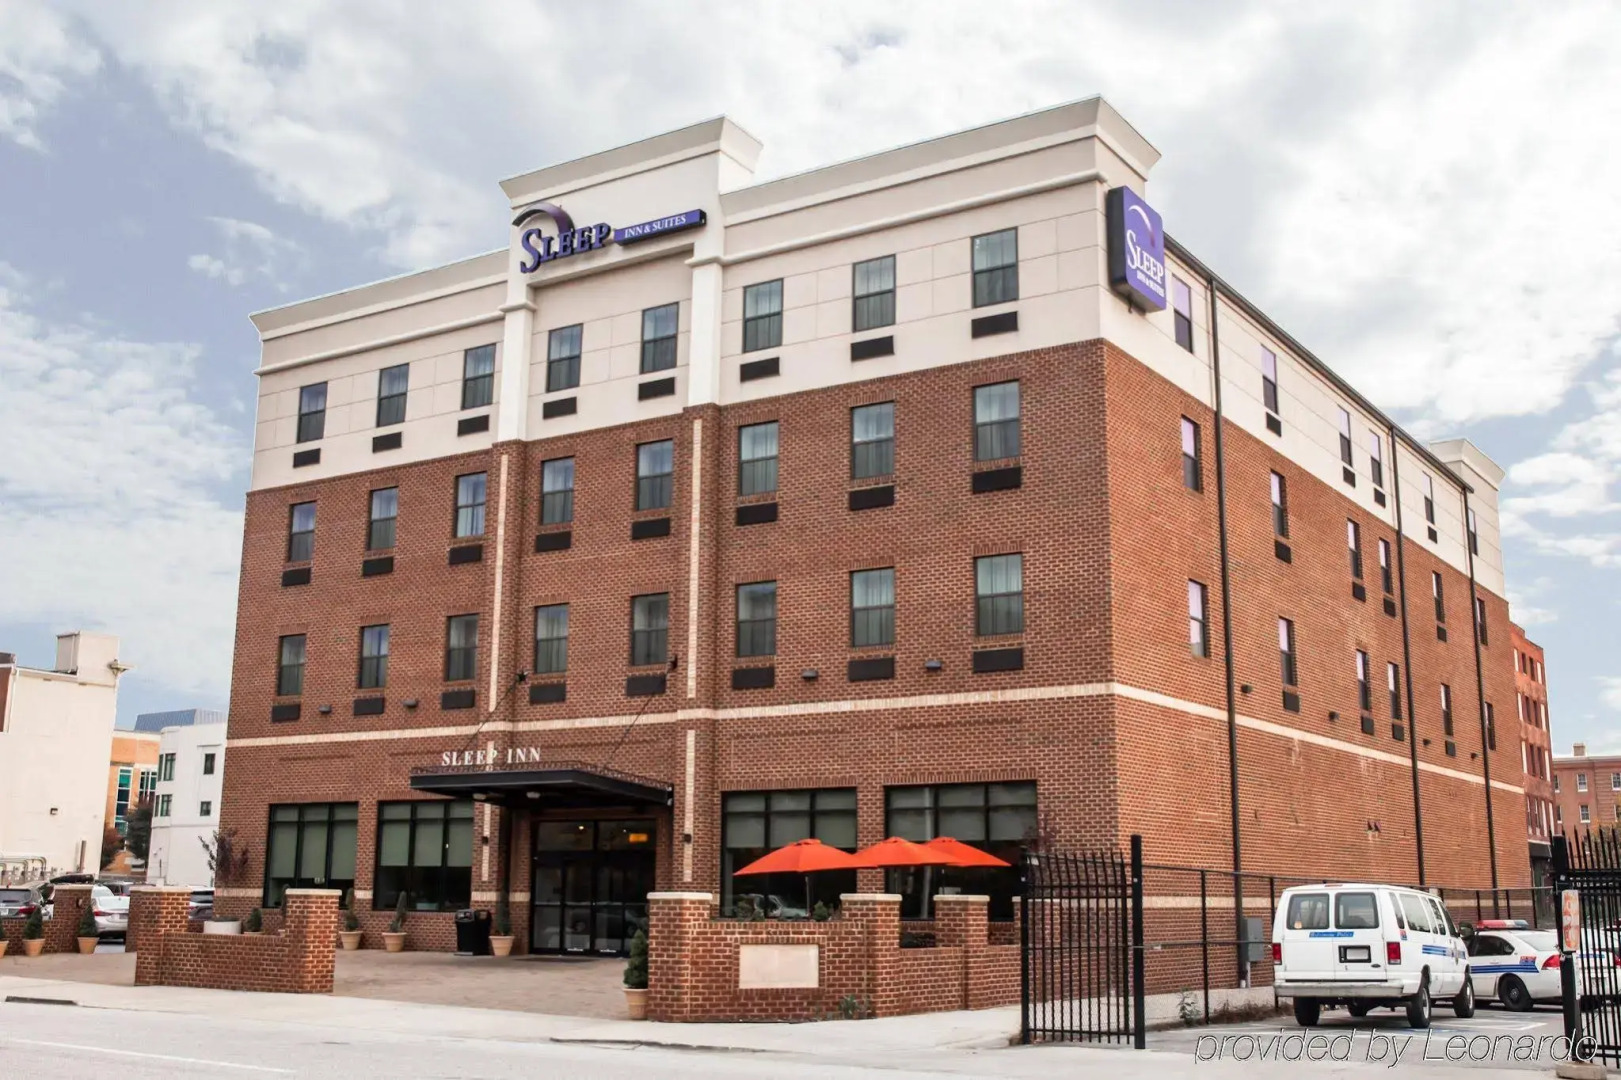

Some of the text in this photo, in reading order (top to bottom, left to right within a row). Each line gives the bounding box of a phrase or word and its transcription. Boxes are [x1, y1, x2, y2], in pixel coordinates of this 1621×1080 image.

[521, 214, 687, 273] SLEEP INN & SUITES
[1126, 229, 1164, 284] SLEEP
[441, 746, 541, 766] SLEEP INN
